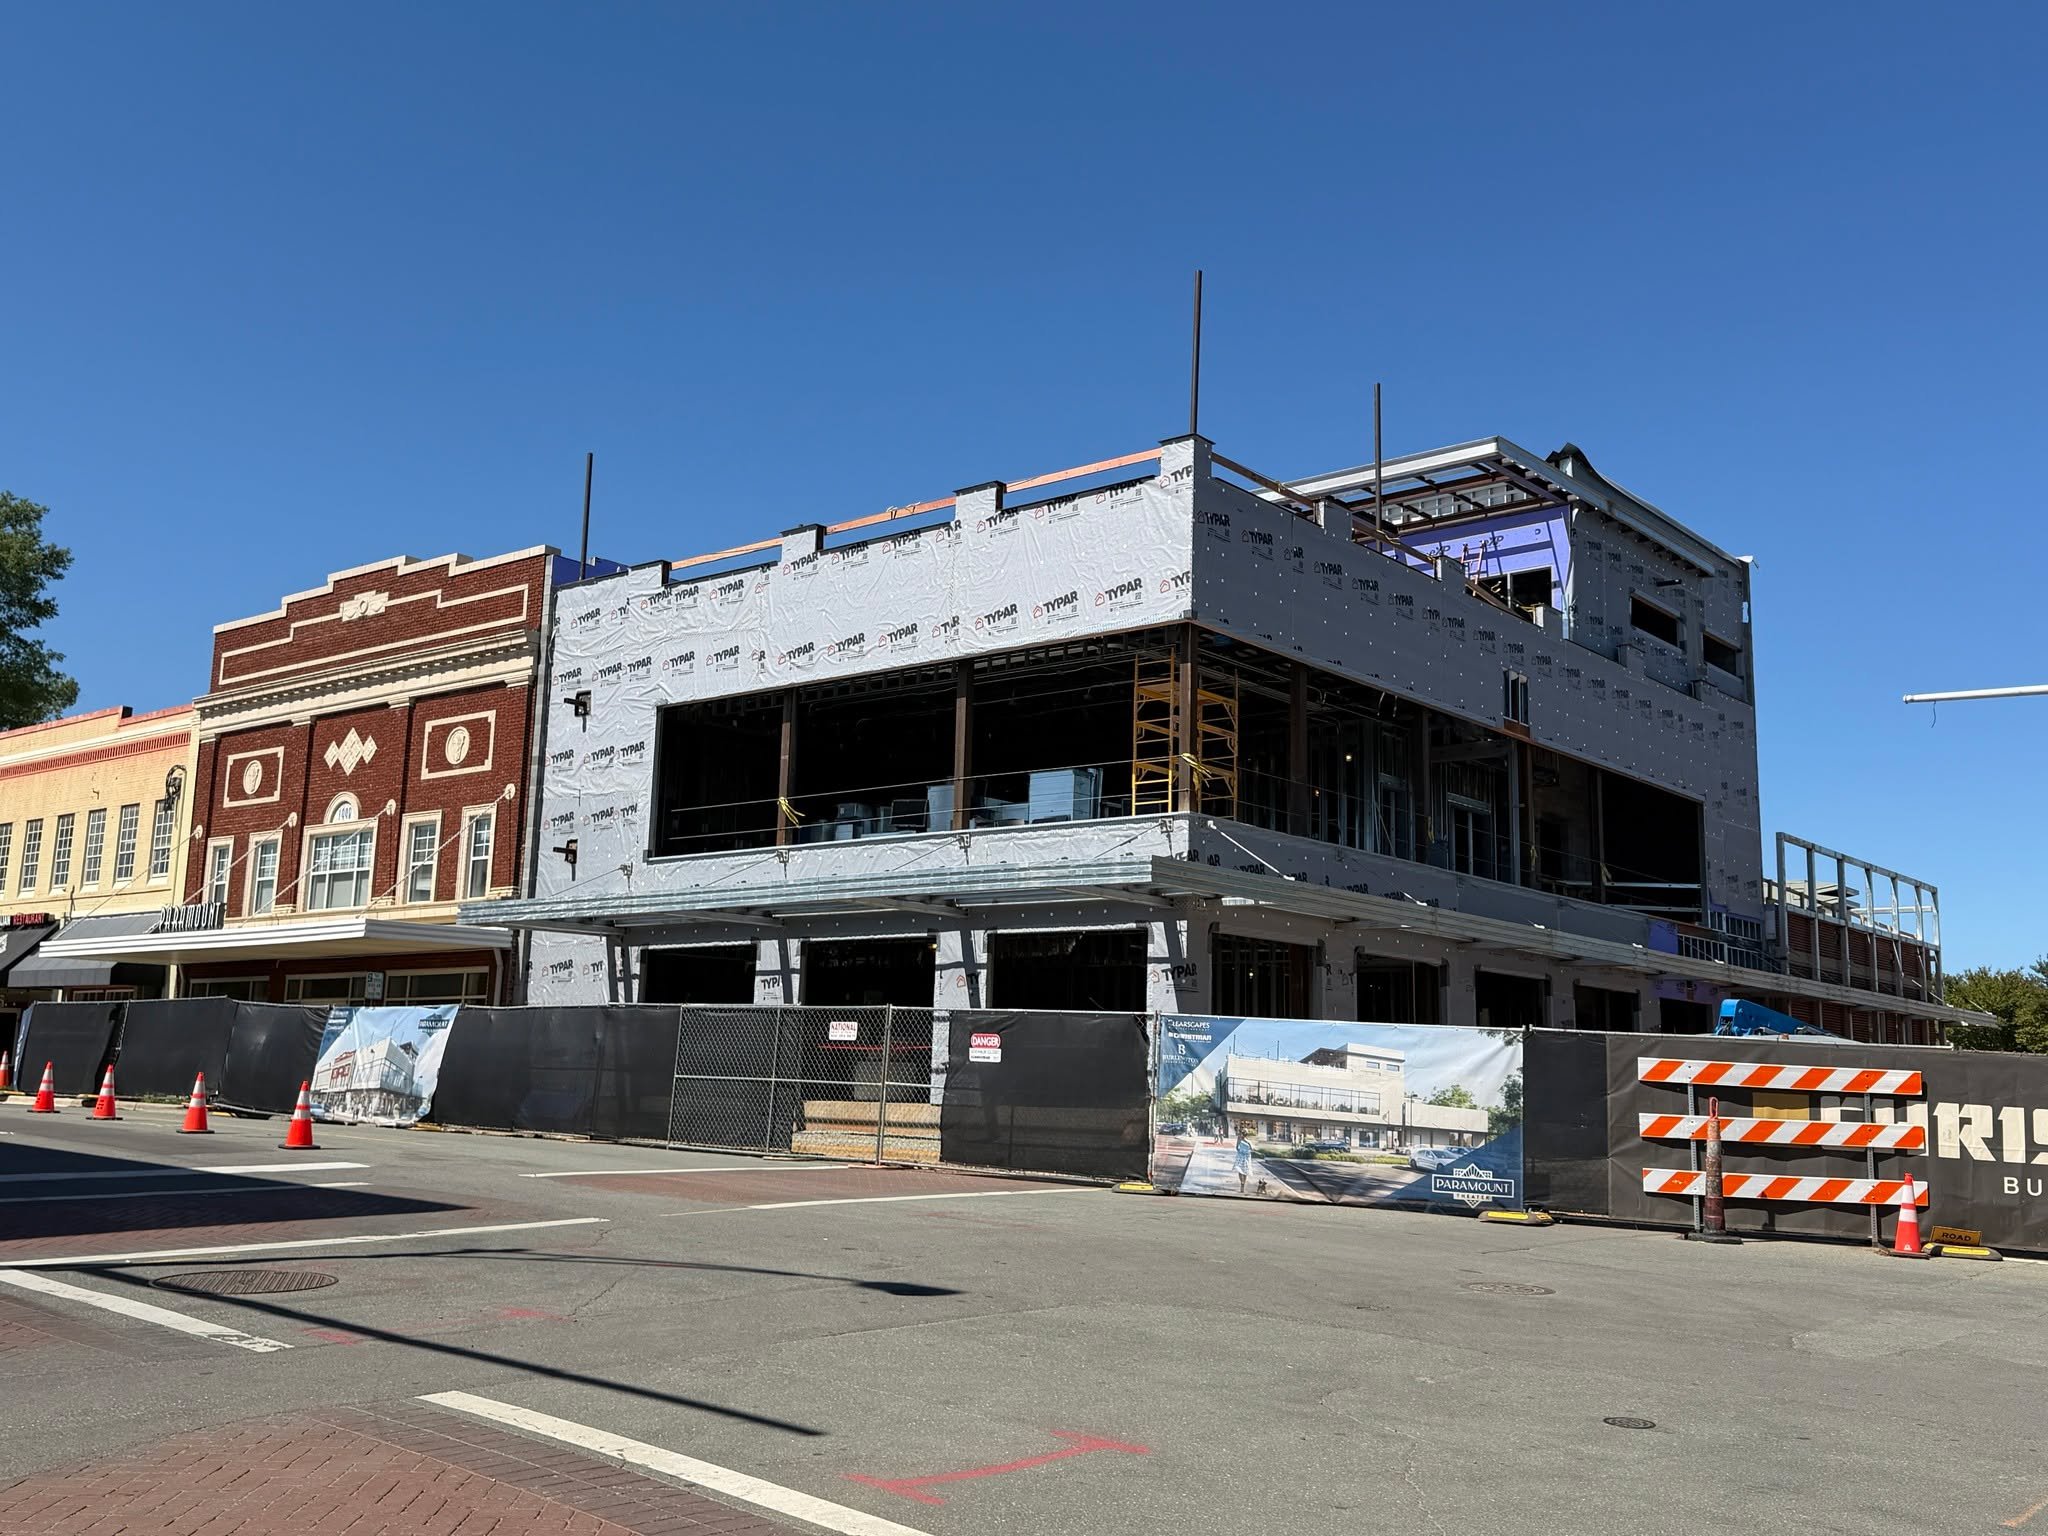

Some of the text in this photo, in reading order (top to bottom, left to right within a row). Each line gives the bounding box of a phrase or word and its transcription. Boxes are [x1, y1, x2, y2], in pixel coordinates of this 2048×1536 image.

[1205, 512, 1231, 527] TYPAR
[1249, 531, 1273, 546] TYPAR
[791, 551, 819, 571] TYPAR
[1320, 562, 1342, 576] TYPAR
[648, 585, 672, 605] TYPAR
[675, 585, 699, 602] TYPAR
[718, 579, 744, 597] TYPAR
[1105, 578, 1143, 602] TYPAR
[1043, 591, 1079, 614] TYPAR
[577, 608, 600, 625] TYPAR
[984, 603, 1018, 625] TYPAR
[887, 623, 918, 644] TYPAR
[786, 641, 815, 661] TYPAR
[836, 633, 865, 652] TYPAR
[669, 651, 696, 668] TYPAR
[713, 645, 740, 663] TYPAR
[599, 662, 623, 679] TYPAR
[627, 656, 652, 673] TYPAR
[559, 667, 582, 683] TYPAR
[551, 749, 574, 764] TYPAR
[591, 746, 615, 761] TYPAR
[621, 741, 645, 758] TYPAR
[551, 811, 575, 827] TYPAR
[159, 902, 221, 930] PARAMOUNT
[550, 959, 574, 975] TYPAR
[1161, 963, 1198, 981] TYPAR
[972, 1036, 1000, 1047] DANGER
[1436, 1178, 1510, 1194] PARAMOUNT
[1456, 1193, 1491, 1201] THEATER
[1942, 1232, 1973, 1242] ROAD
